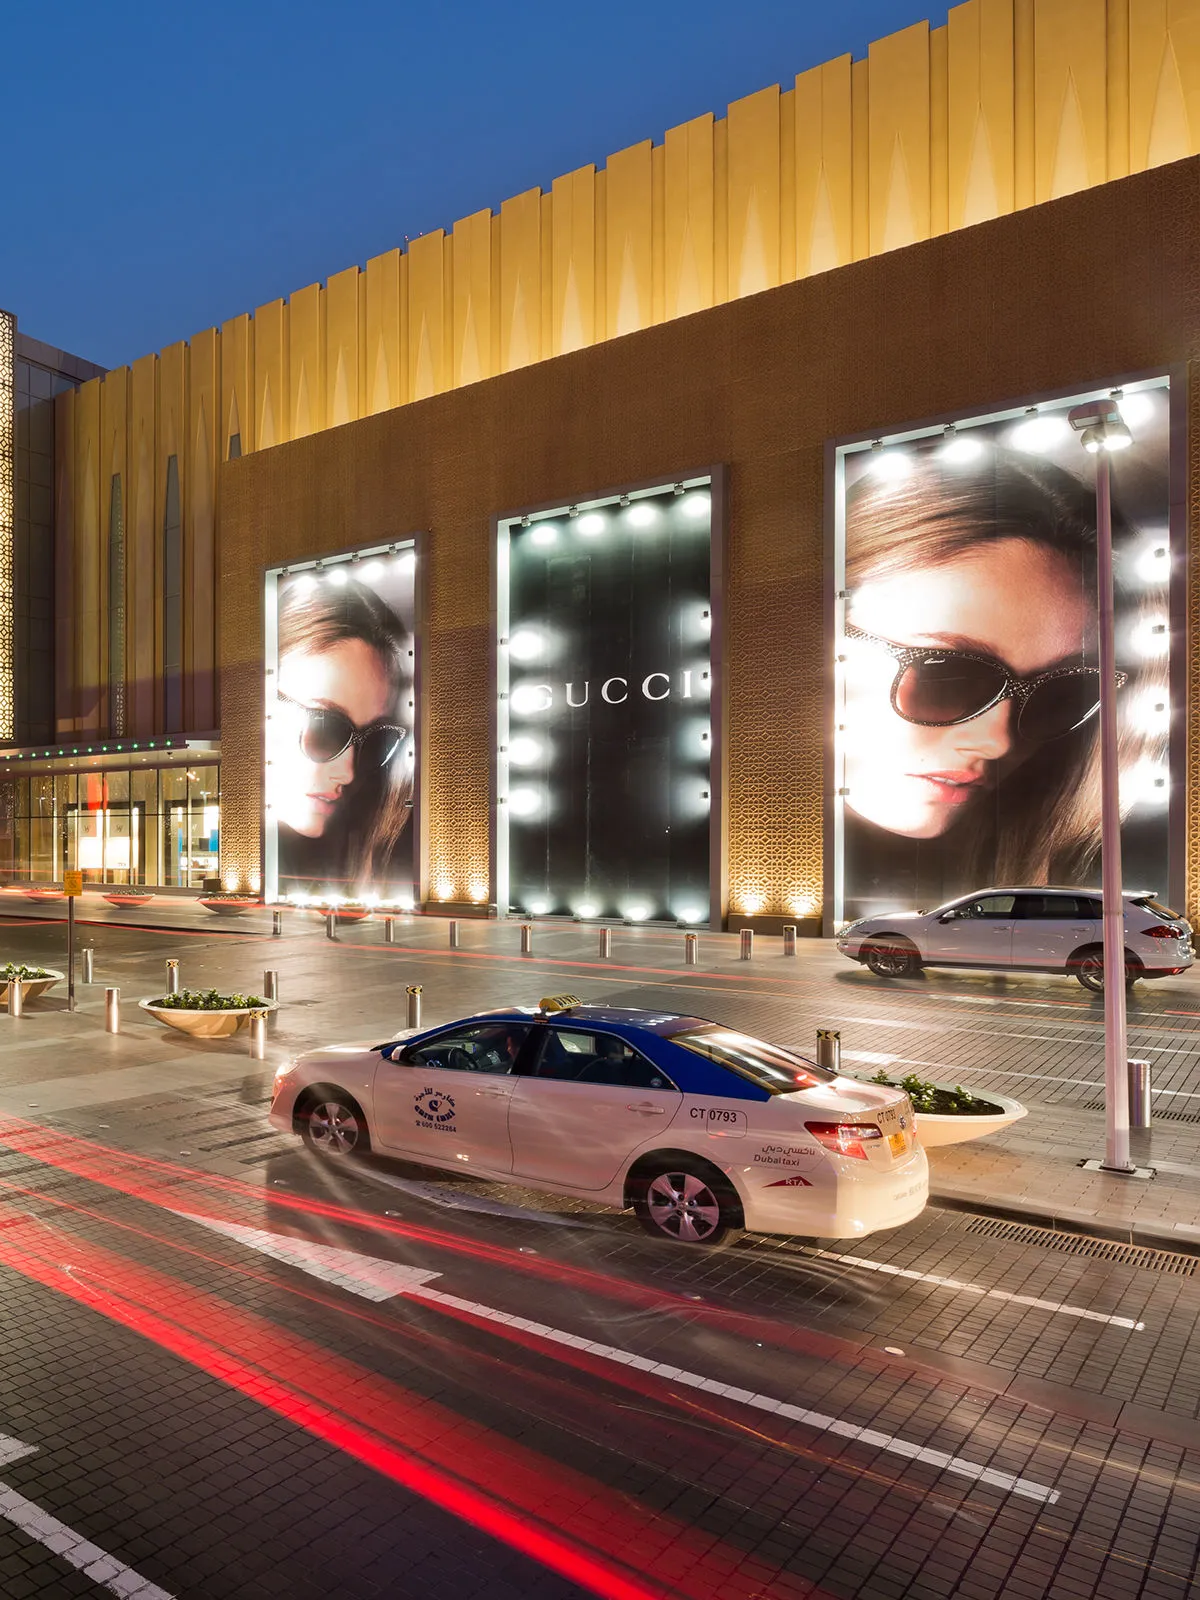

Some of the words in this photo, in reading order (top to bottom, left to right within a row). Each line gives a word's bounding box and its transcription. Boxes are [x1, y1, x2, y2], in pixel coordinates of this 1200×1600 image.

[525, 671, 692, 712] GUCCI
[689, 1107, 706, 1119] CT
[709, 1110, 737, 1123] 0793
[753, 1154, 781, 1164] Dubai
[782, 1158, 800, 1167] taxi
[785, 1179, 805, 1187] RTA
